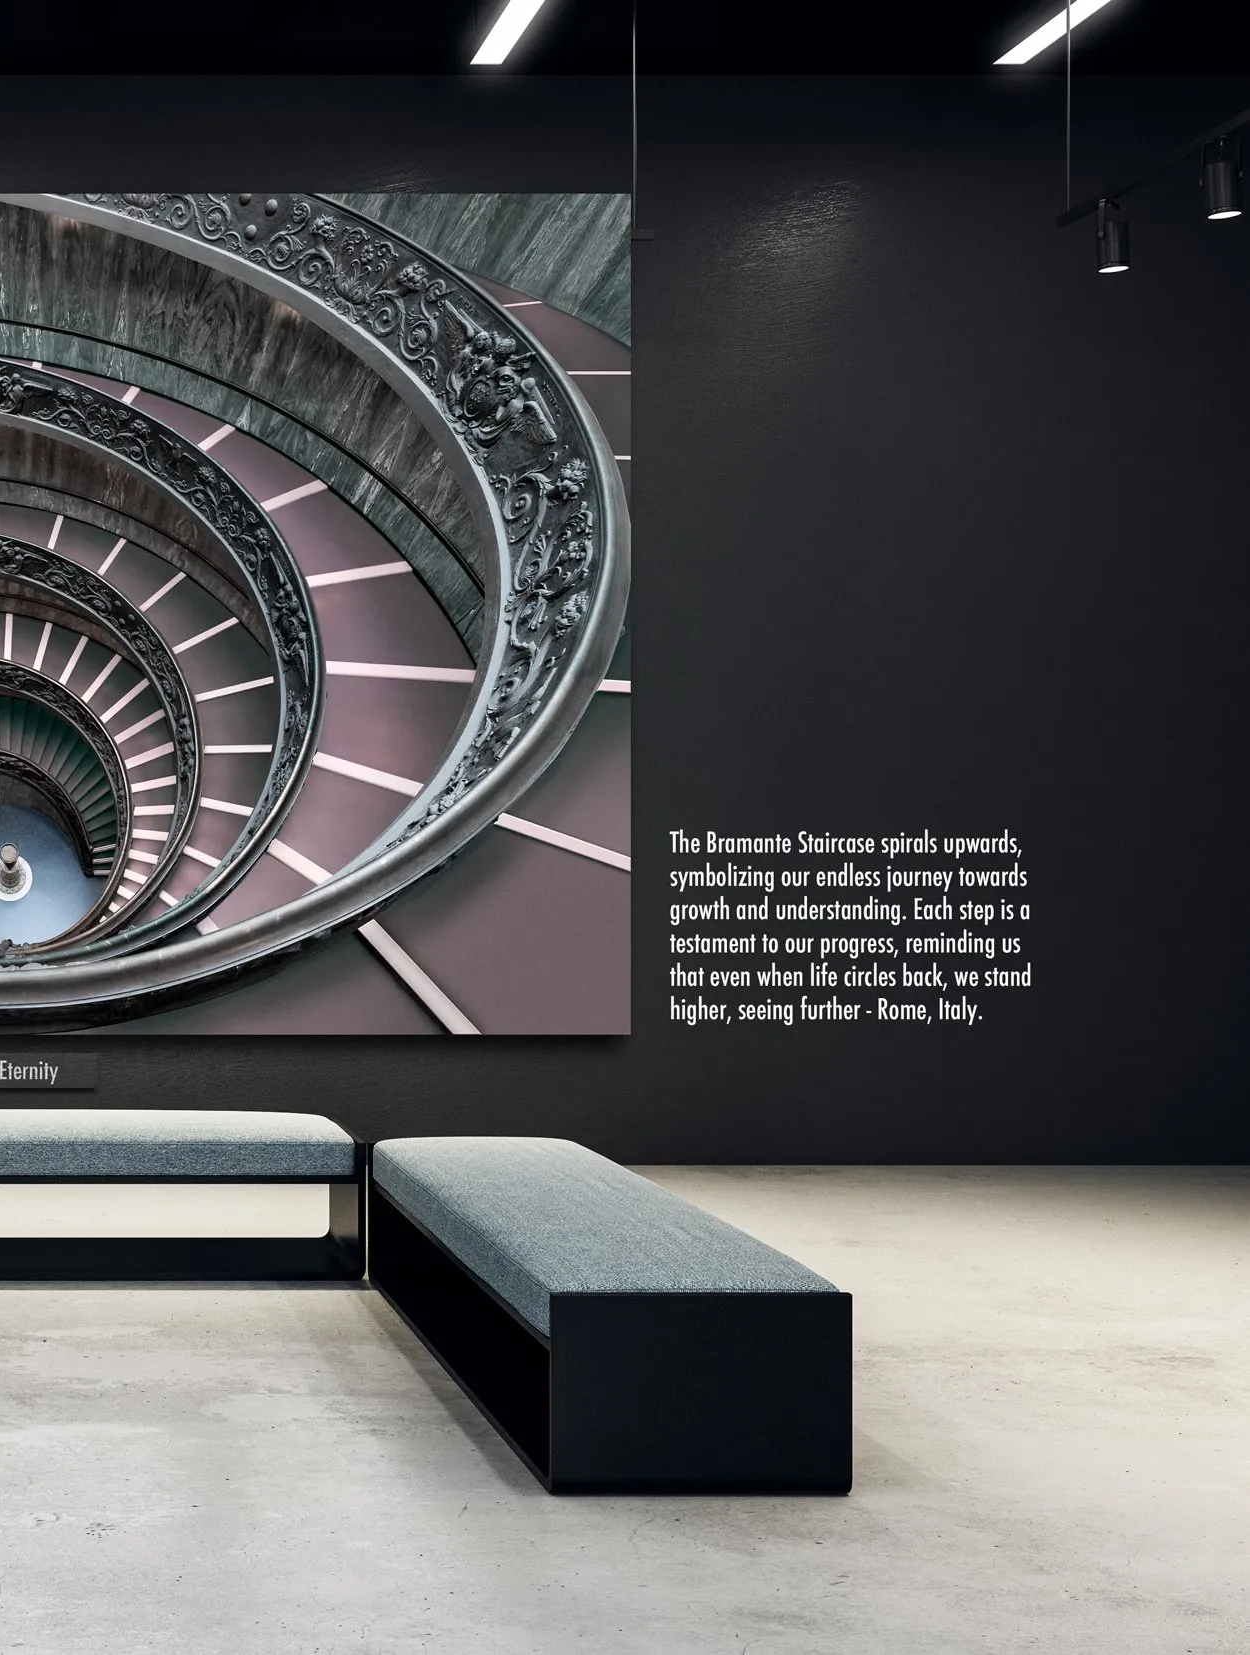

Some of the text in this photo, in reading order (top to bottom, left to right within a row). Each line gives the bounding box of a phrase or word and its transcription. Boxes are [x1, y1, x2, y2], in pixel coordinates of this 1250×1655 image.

[668, 828, 1022, 860] The Bramante Staircase spirals upwards,
[669, 861, 1028, 893] symbolizing our endless journey towards
[669, 895, 1030, 926] growth and understanding. Each step is a
[669, 928, 1021, 960] testament to our progress, reminding us
[669, 961, 1031, 992] that even when life circles back, we stand
[670, 995, 732, 1026] higher,
[738, 998, 794, 1026] seeing
[799, 995, 861, 1021] further
[877, 997, 932, 1025] Rome,
[938, 995, 983, 1026] Italy.
[0, 1059, 59, 1086] Eternity
